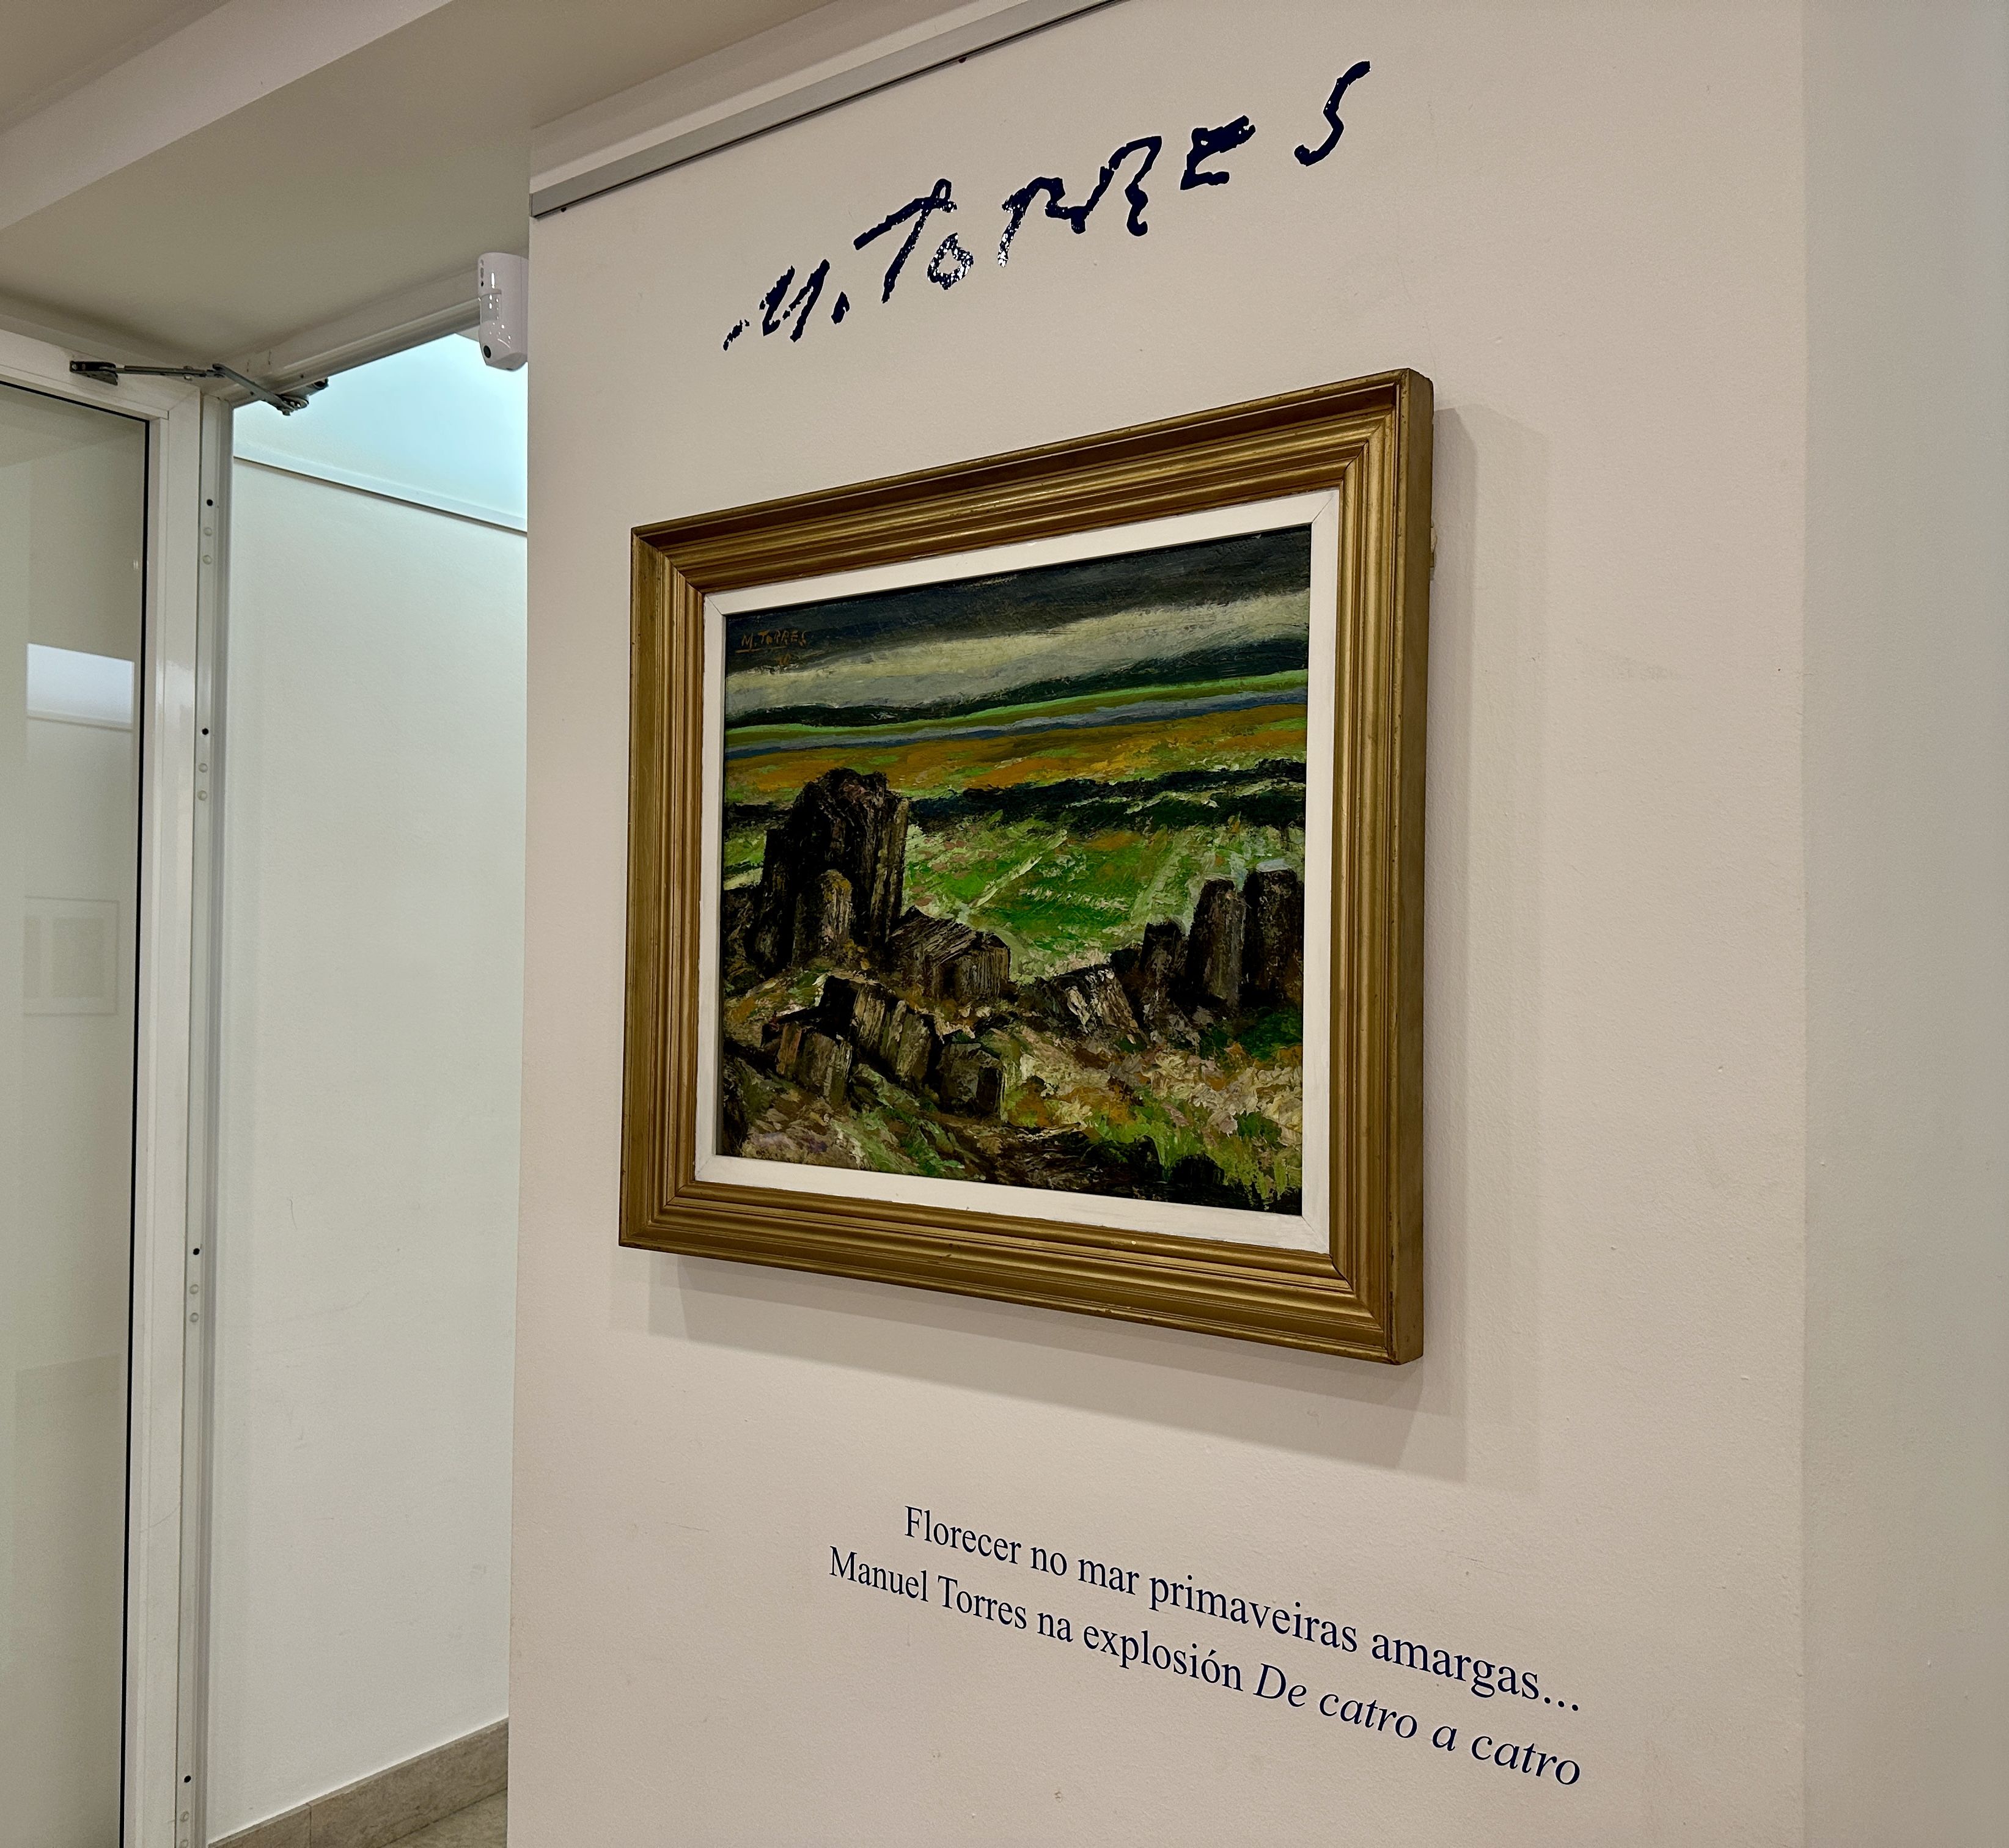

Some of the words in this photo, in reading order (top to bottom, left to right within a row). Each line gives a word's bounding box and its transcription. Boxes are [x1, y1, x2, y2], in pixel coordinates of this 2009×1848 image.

[829, 1546, 928, 1602] Manuel
[938, 1575, 1026, 1629] Torres
[1037, 1613, 1073, 1642] na
[1084, 1626, 1243, 1692] explosión
[1253, 1663, 1307, 1707] De
[1320, 1694, 1417, 1738] catro
[1433, 1726, 1456, 1751] a
[1472, 1736, 1579, 1784] catro
[905, 1506, 1021, 1564] Florecer
[1030, 1547, 1067, 1575] no
[1078, 1560, 1139, 1595] mar
[1148, 1575, 1357, 1652] primaveiras
[1372, 1635, 1578, 1711] amargas...
